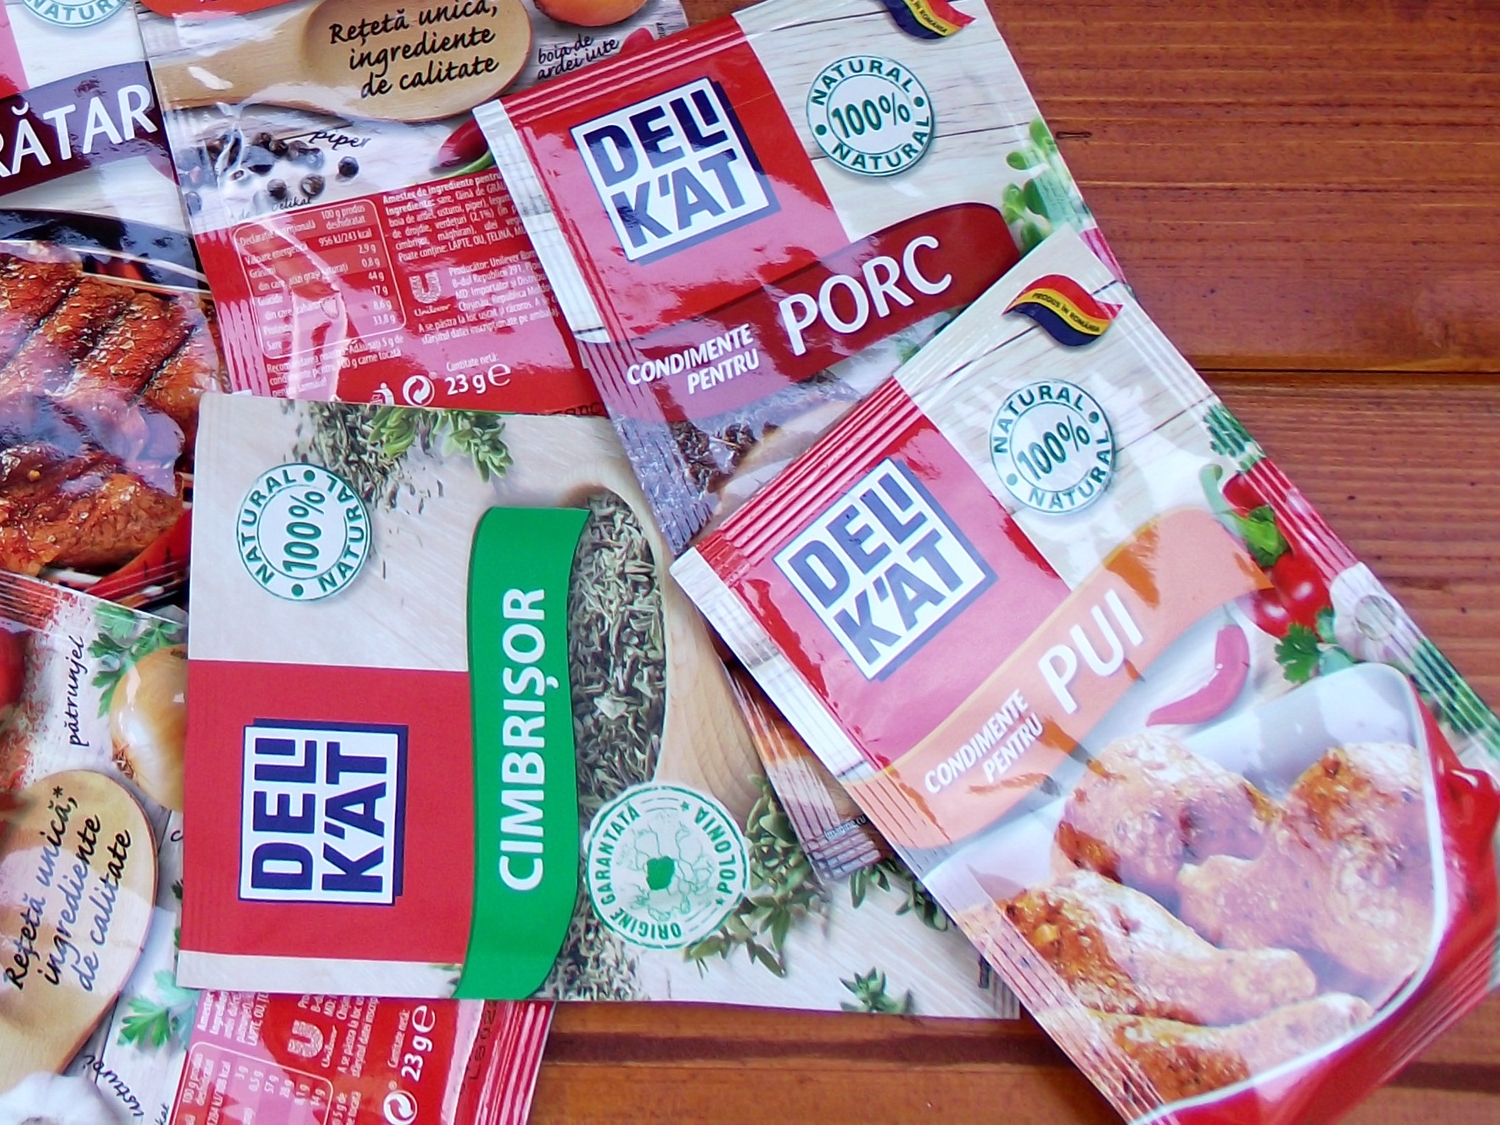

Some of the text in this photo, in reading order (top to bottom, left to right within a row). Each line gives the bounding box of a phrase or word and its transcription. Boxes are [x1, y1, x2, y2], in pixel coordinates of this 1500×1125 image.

[329, 9, 409, 46] Rețetă
[350, 27, 496, 78] ingrediente
[537, 39, 620, 80] ardei iute
[538, 34, 594, 64] boia de
[361, 56, 499, 99] de calitate
[811, 59, 915, 106] NATURAL
[831, 92, 910, 139] 100%
[308, 130, 372, 150] piper
[583, 89, 727, 182] DELI
[831, 116, 930, 170] NATURAL
[627, 325, 755, 385] CONDIMENTE
[776, 234, 952, 356] PORC
[445, 374, 469, 395] 23
[687, 349, 760, 394] PENTRU
[994, 385, 1085, 453] NATURAL
[1017, 414, 1091, 480] 100%
[1029, 430, 1112, 509] NATURAL
[241, 469, 297, 586] NATURAL
[282, 490, 326, 572] 100%
[317, 475, 365, 593] NATURAL
[789, 471, 927, 611] DELI
[66, 635, 89, 748] pătrunjel
[924, 588, 1144, 794] CONDIMENTE PUI
[497, 587, 561, 893] CIMBRIȘOR
[982, 712, 1044, 783] PENTRU
[251, 737, 316, 892] DELI
[694, 806, 737, 895] POLONIA
[36, 814, 101, 986] ingrediente
[595, 801, 682, 940] ORIGINE GARANTATĂ
[4, 893, 46, 991] Rețetă
[70, 829, 132, 992] de calitate
[401, 1053, 424, 1082] 23
